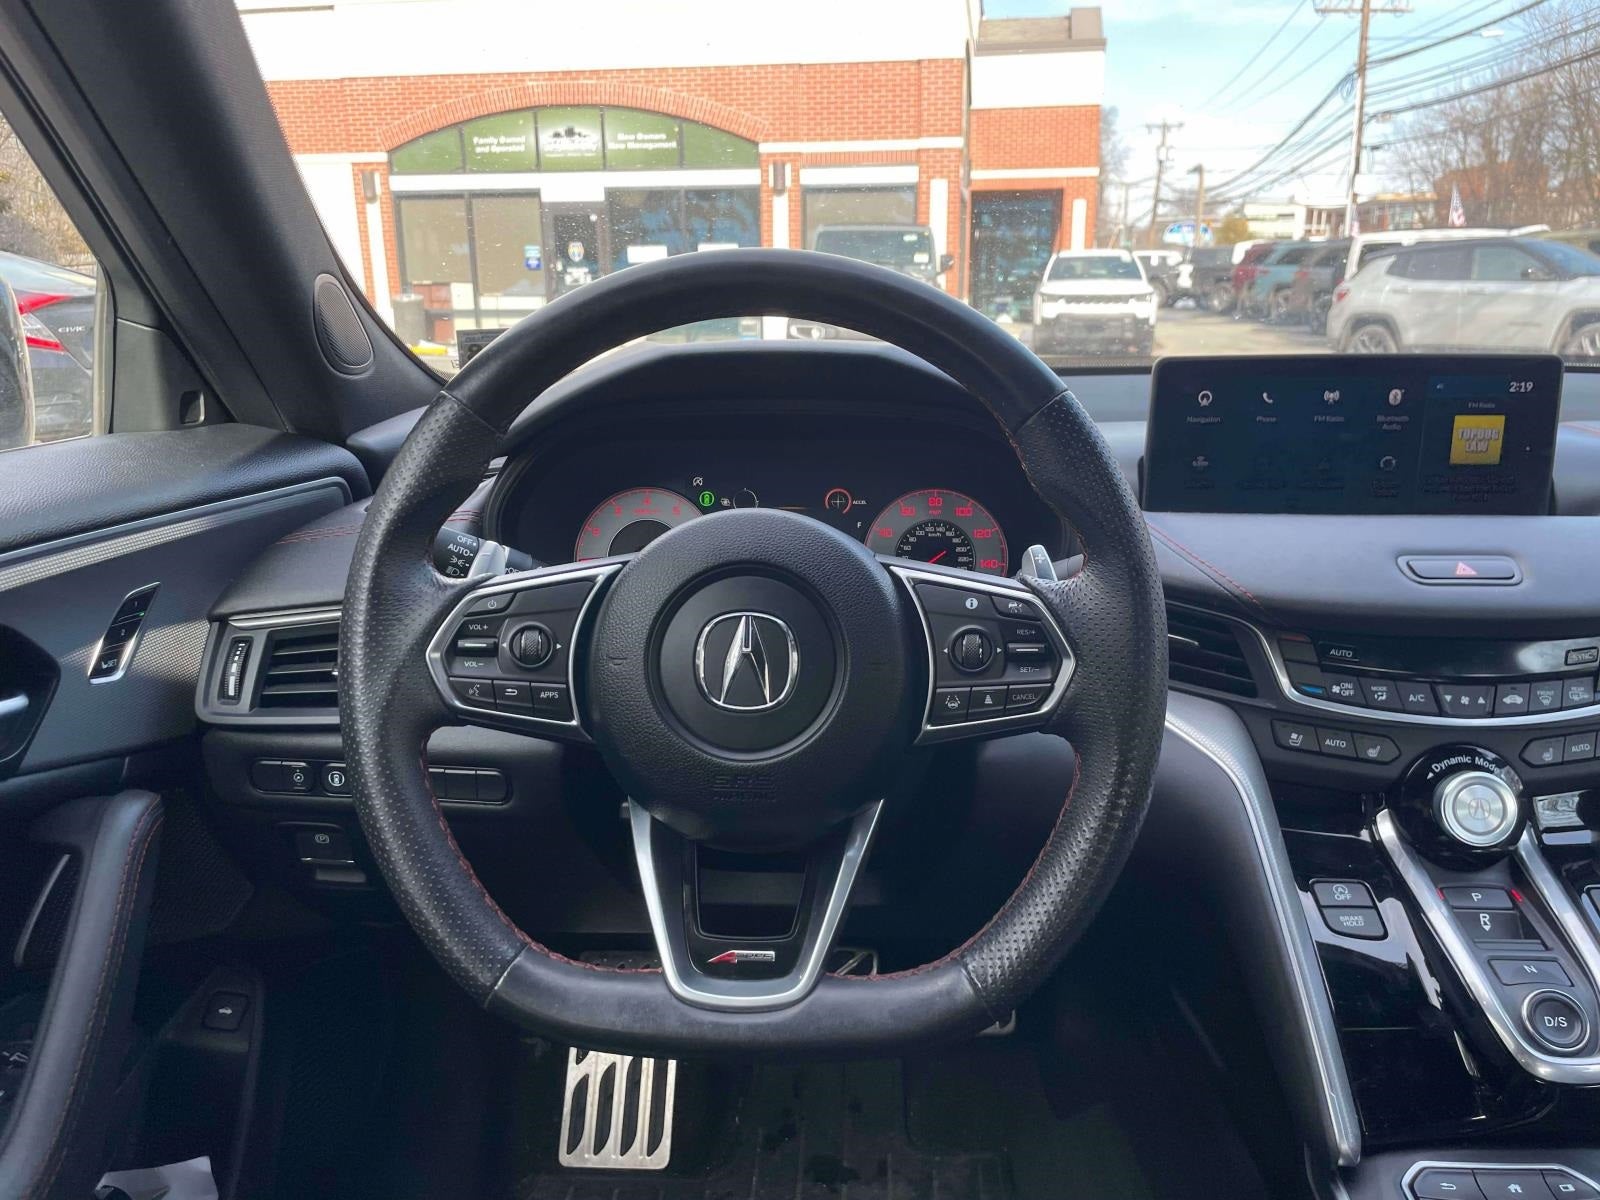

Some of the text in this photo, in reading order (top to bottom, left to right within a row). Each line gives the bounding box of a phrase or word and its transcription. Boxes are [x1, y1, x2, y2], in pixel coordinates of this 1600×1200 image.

[472, 136, 499, 146] Family
[626, 141, 678, 151] Management
[491, 144, 525, 154] Operated
[58, 325, 85, 333] CIVIC
[1508, 381, 1534, 393] 2:19
[1186, 415, 1221, 424] Navigation
[1256, 415, 1277, 423] Phone
[1314, 415, 1345, 423] FM Radio
[857, 521, 862, 529] F
[973, 528, 992, 539] 120
[457, 535, 473, 546] OFF
[448, 543, 471, 557] AUTO
[980, 559, 999, 570] 140
[1329, 649, 1353, 658] AUTO
[1340, 682, 1353, 690] ON/
[540, 691, 559, 699] APPS
[1012, 693, 1037, 701] CANCEL
[1341, 689, 1354, 697] OFF
[1409, 694, 1425, 702] A/C
[1325, 738, 1347, 748] AUTO
[1571, 743, 1591, 753] AUTO
[1431, 754, 1471, 774] Dynamic
[1334, 893, 1352, 901] OFF
[1471, 892, 1482, 902] P
[1479, 913, 1490, 926] R
[1523, 964, 1538, 973] N
[1543, 1016, 1567, 1027] D/S
